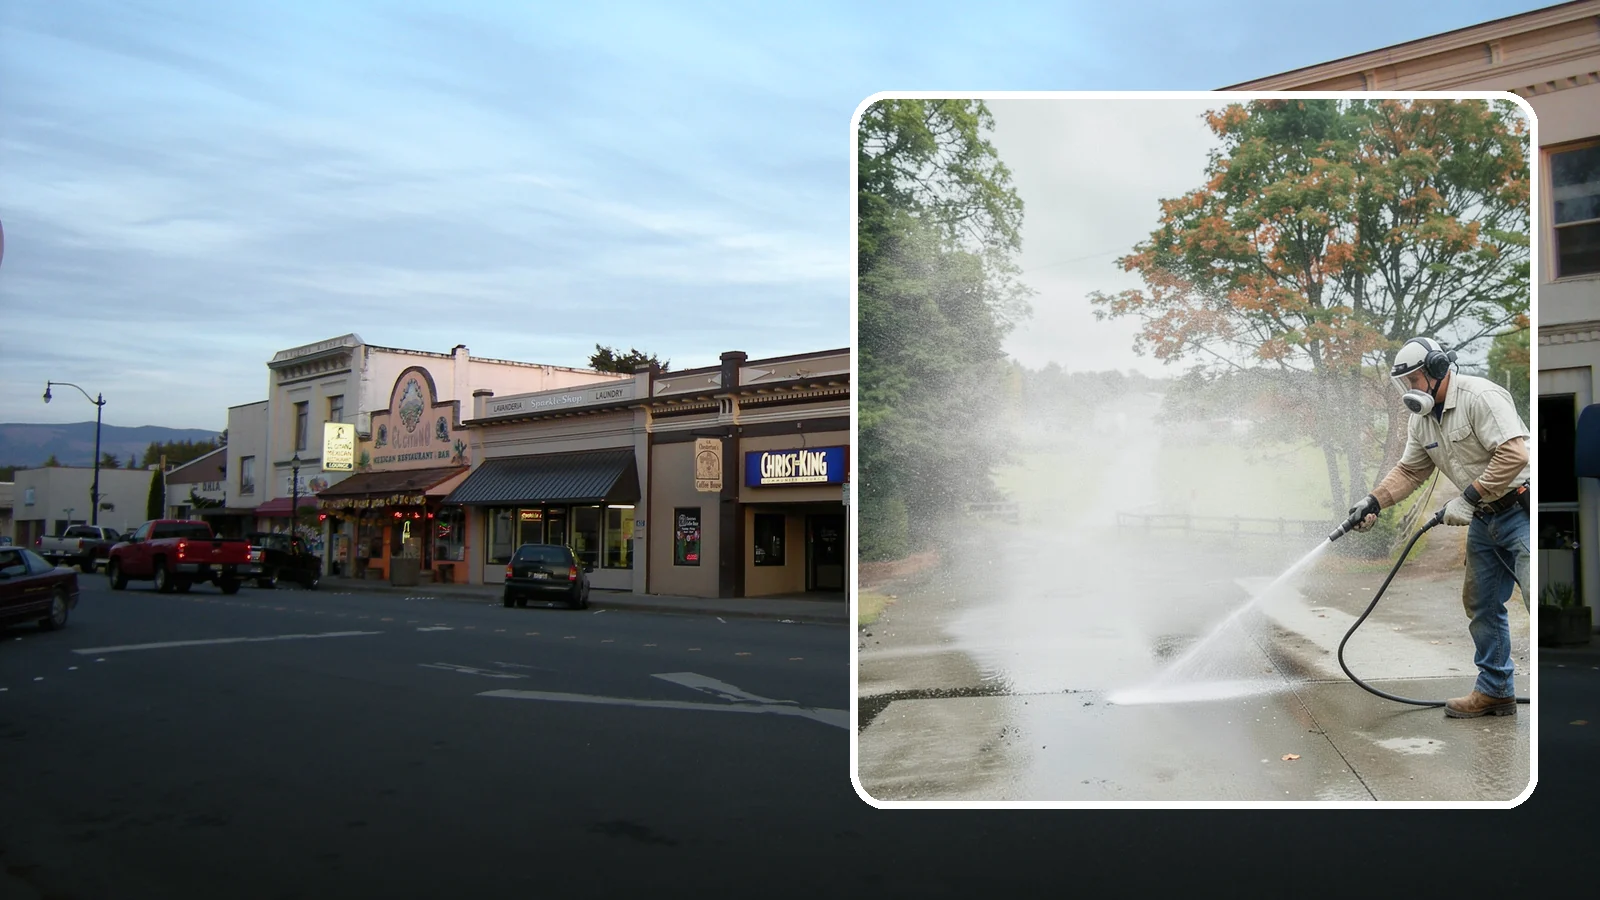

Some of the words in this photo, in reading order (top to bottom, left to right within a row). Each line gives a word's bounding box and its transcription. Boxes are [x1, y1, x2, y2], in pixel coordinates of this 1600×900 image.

[531, 398, 561, 409] Sparkle
[562, 394, 583, 406] Shop
[595, 389, 623, 400] LAUNDRY
[493, 402, 522, 412] LAVANDERIA
[392, 425, 402, 449] EL
[374, 455, 396, 464] MEXICAN
[397, 451, 434, 462] RESTAURANT
[438, 450, 450, 459] BAR
[761, 452, 797, 478] CHRIST
[799, 450, 827, 476] KING
